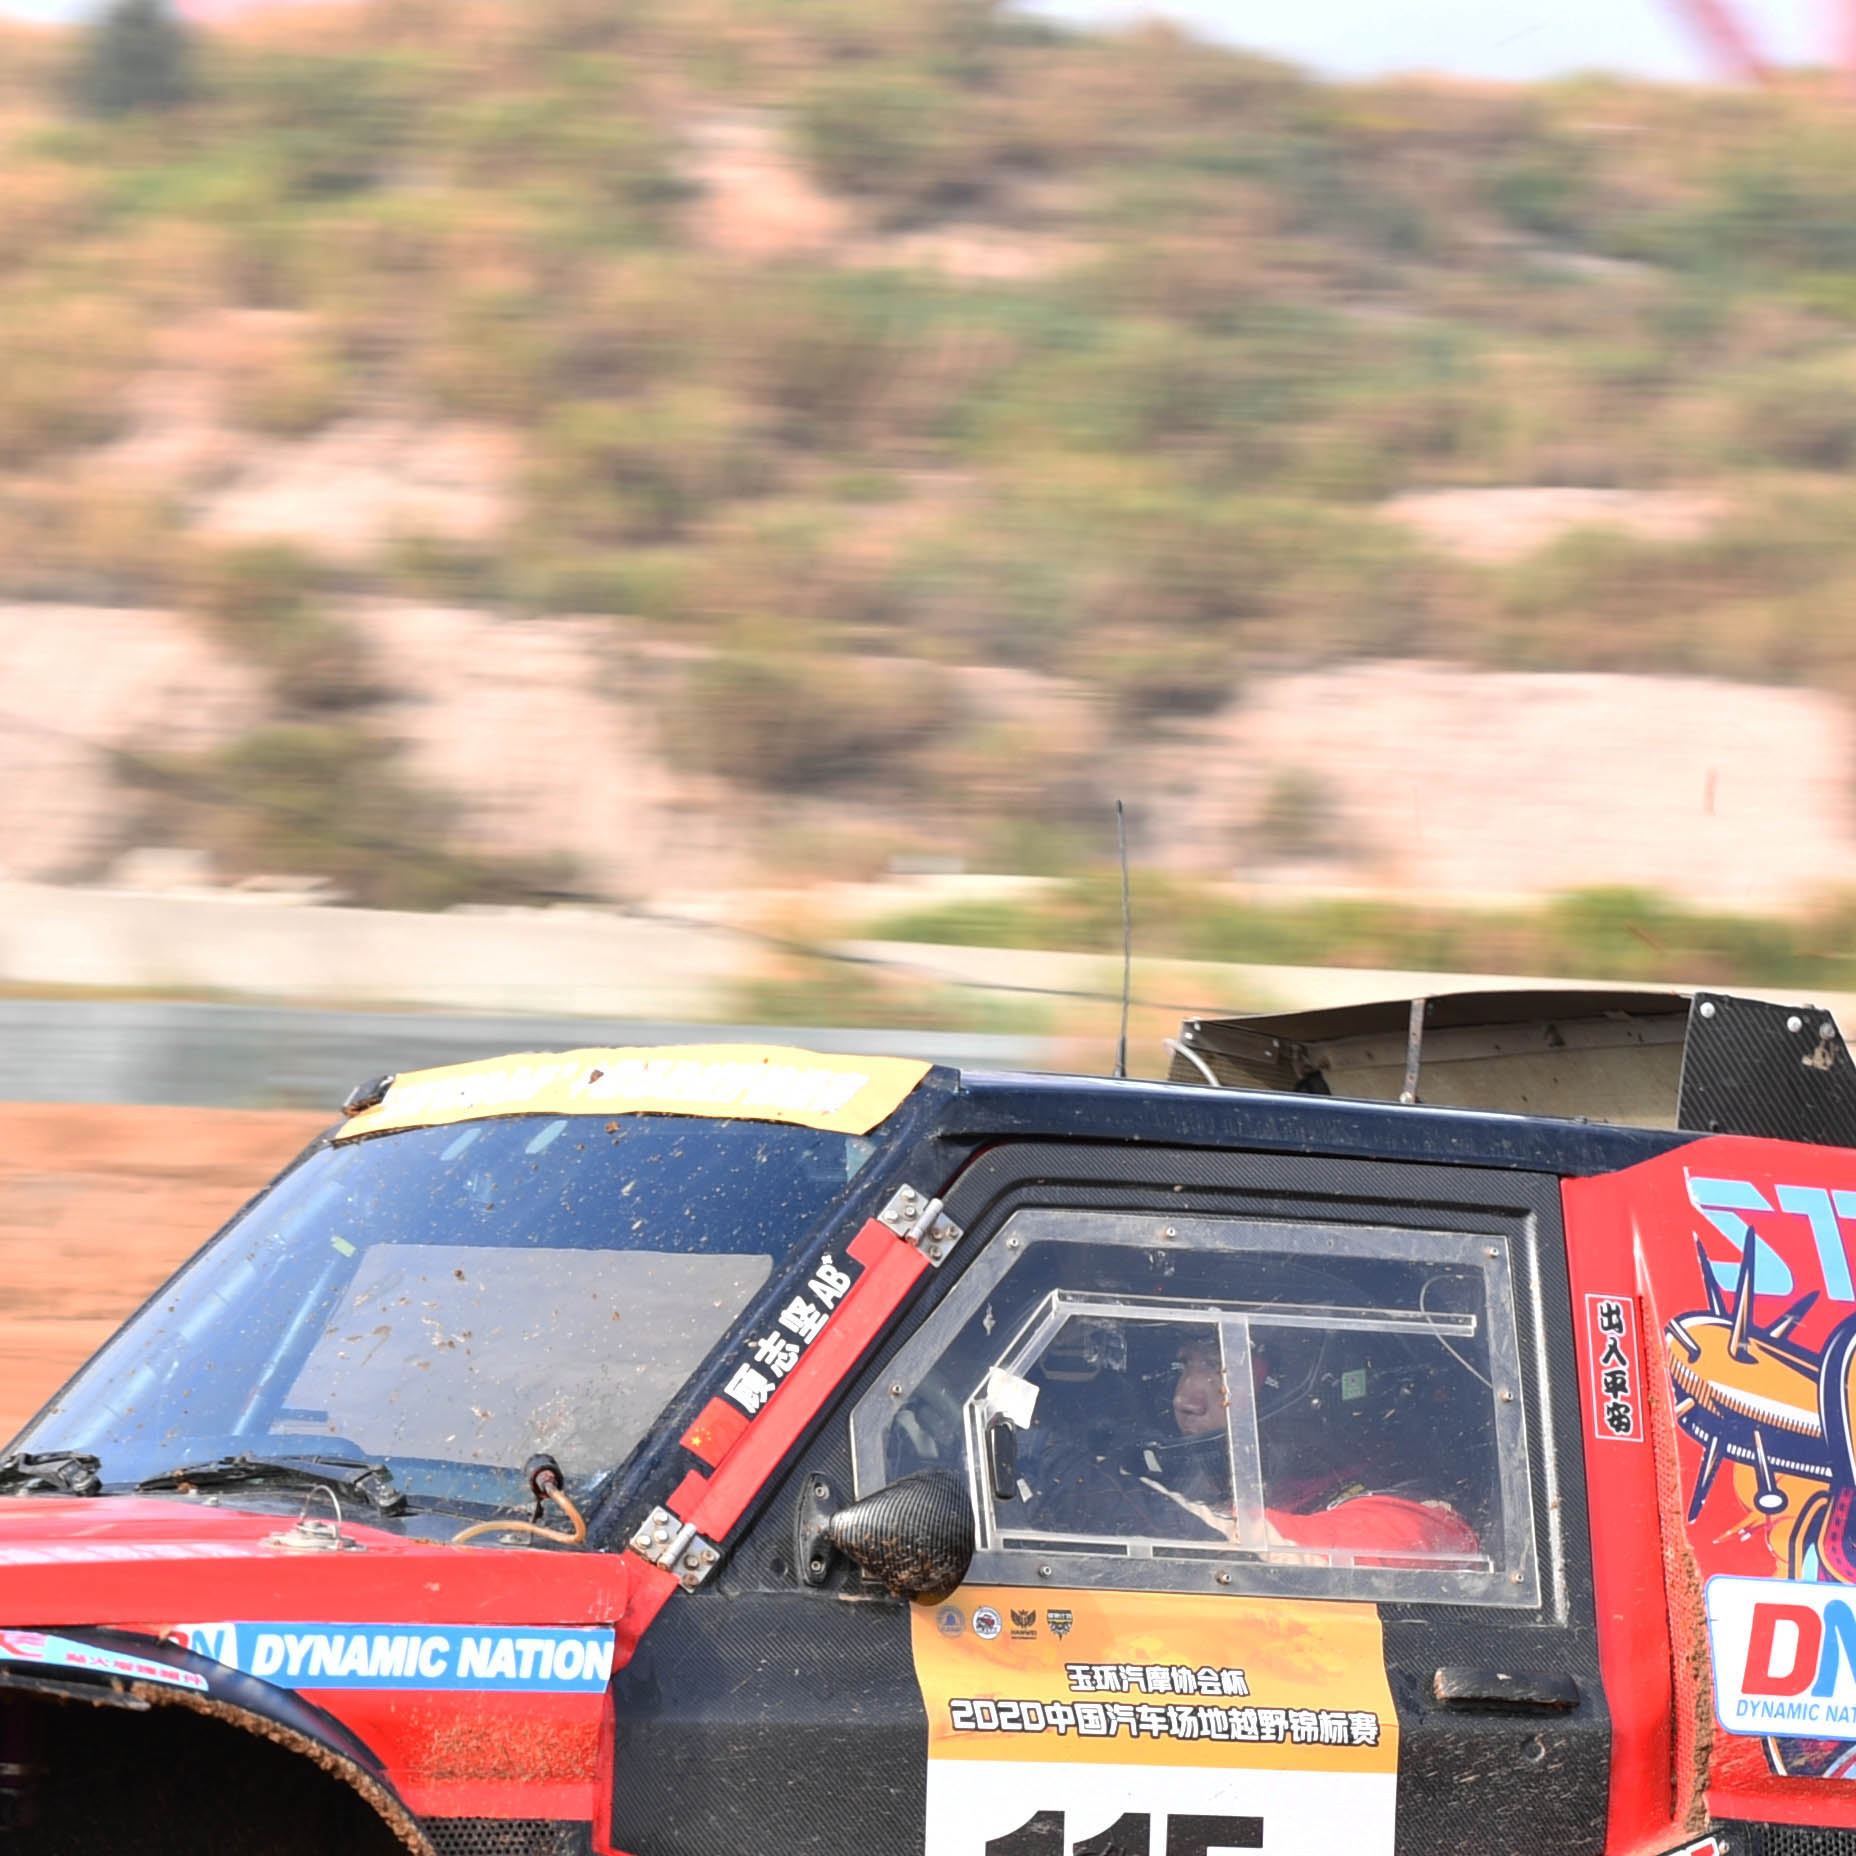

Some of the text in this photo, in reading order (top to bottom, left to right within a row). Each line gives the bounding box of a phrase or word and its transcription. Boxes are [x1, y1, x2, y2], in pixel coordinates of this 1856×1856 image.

[252, 1633, 448, 1677] DYNAMIC
[456, 1637, 615, 1681] NATION
[1065, 1664, 1250, 1697] 玉环汽摩协会杯
[1736, 1699, 1820, 1721] DYNAMIC
